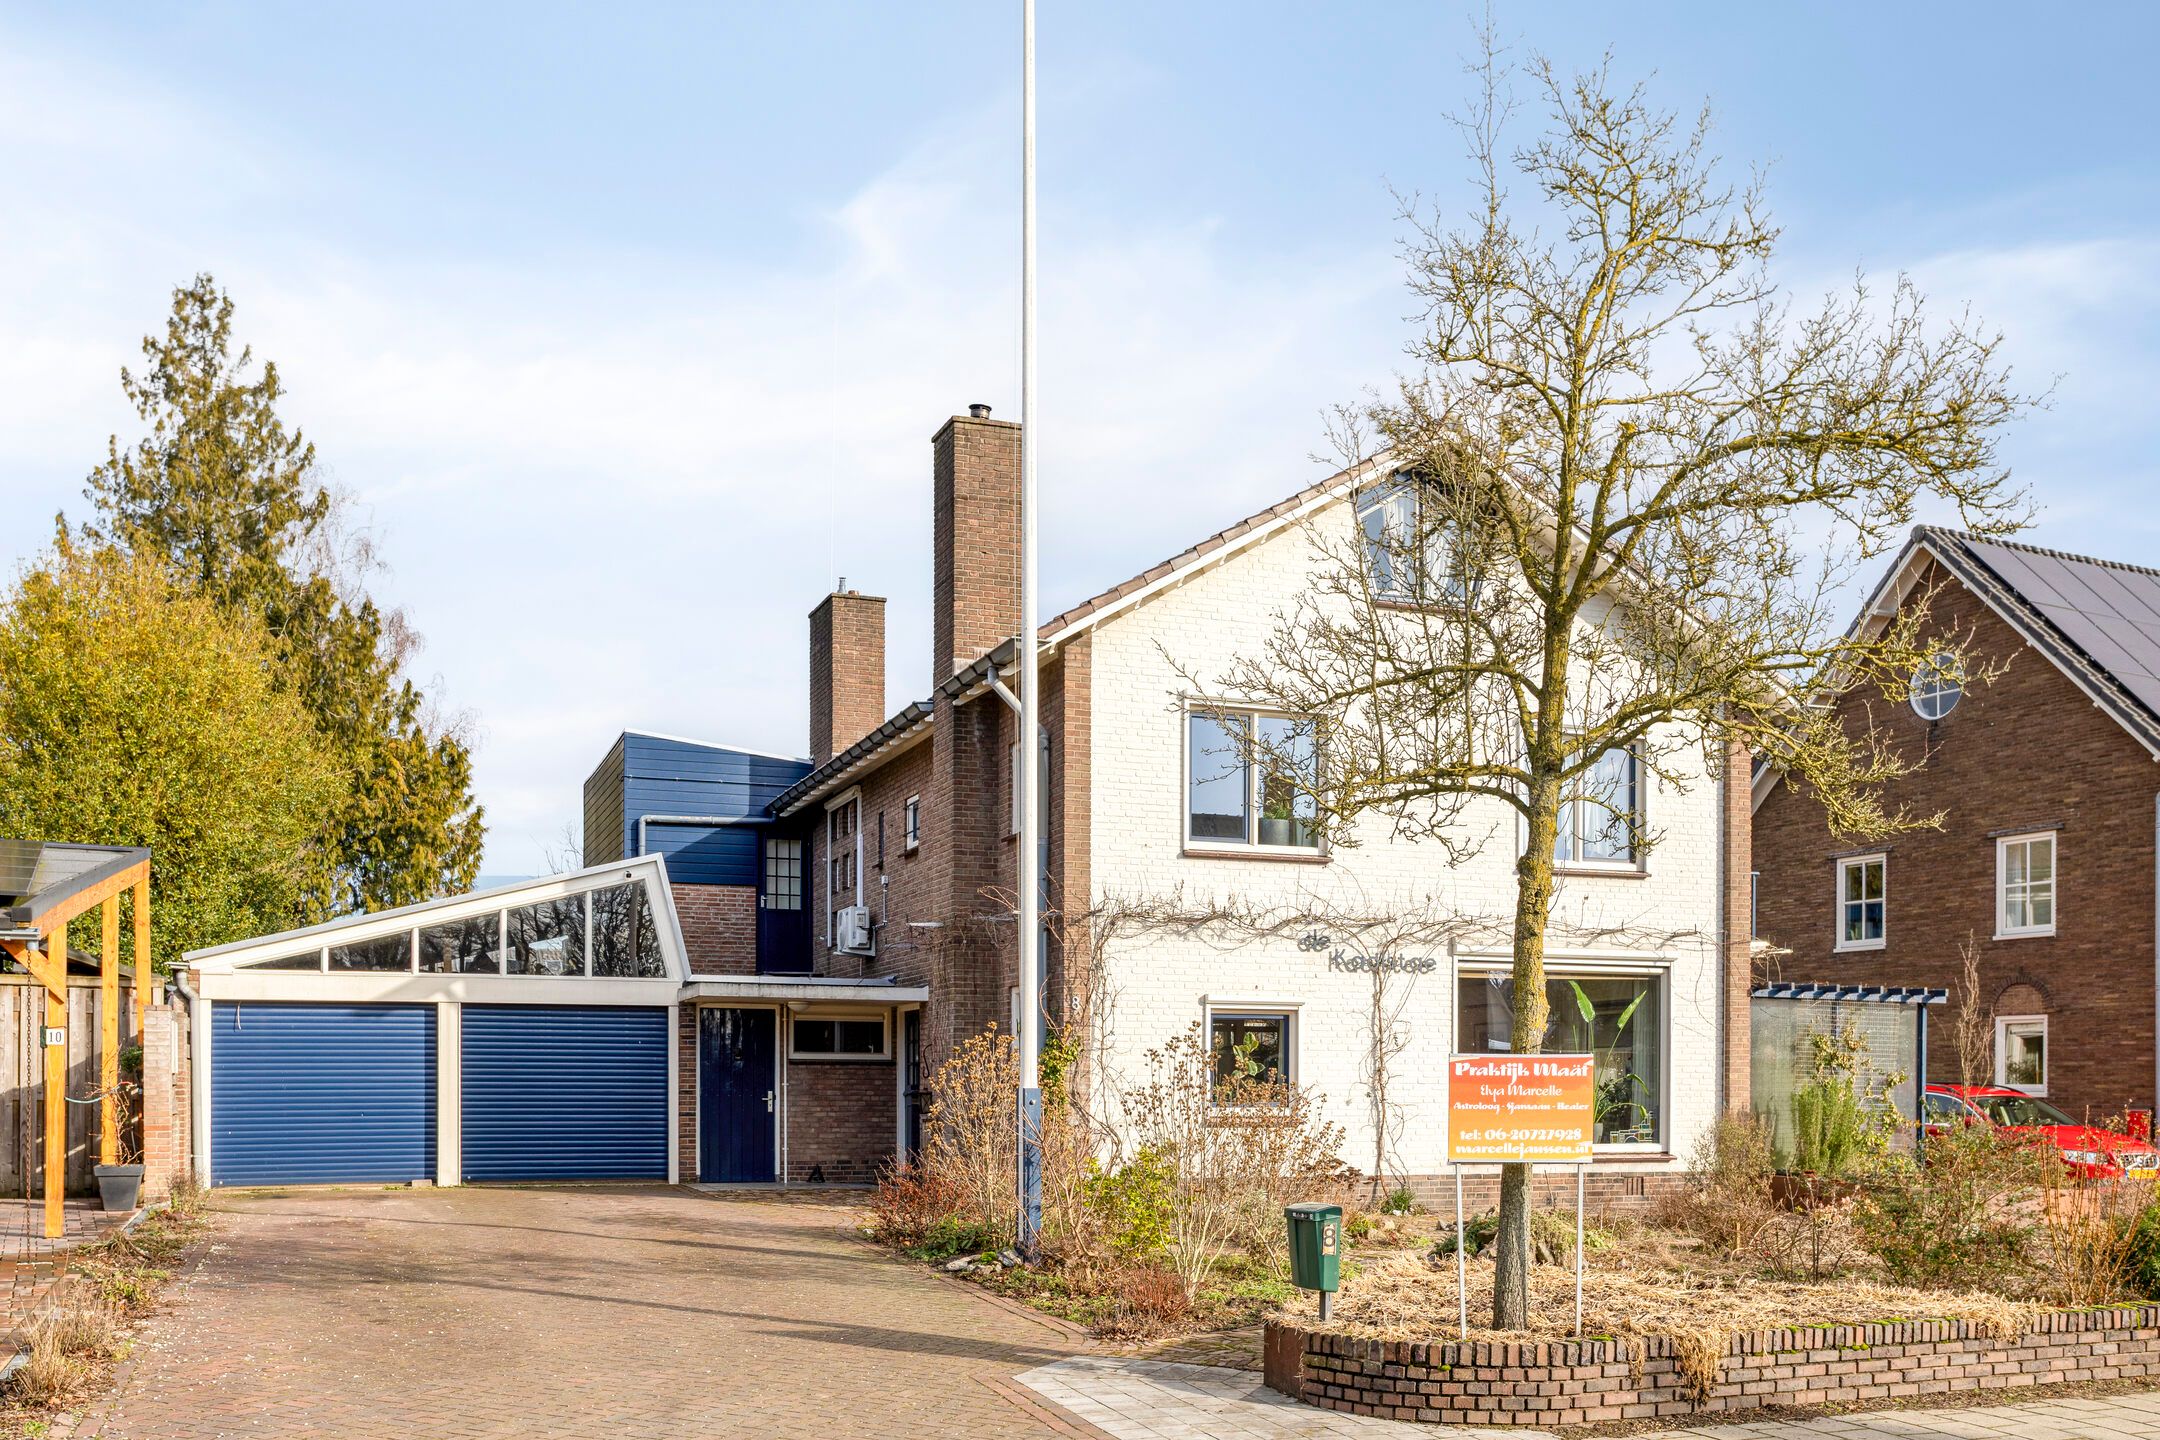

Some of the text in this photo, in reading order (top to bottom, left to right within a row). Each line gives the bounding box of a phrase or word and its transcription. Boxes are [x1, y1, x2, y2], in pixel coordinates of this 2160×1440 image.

[1298, 929, 1331, 952] de
[1072, 996, 1080, 1010] 8
[49, 1031, 62, 1043] 10
[1455, 1062, 1530, 1086] Praktijk
[1507, 1084, 1563, 1097] Marcelle
[1454, 1101, 1500, 1115] Astroloog
[1556, 1101, 1590, 1111] Healer
[1460, 1127, 1582, 1142] tel: 06-20727928
[1324, 1228, 1336, 1247] 8
